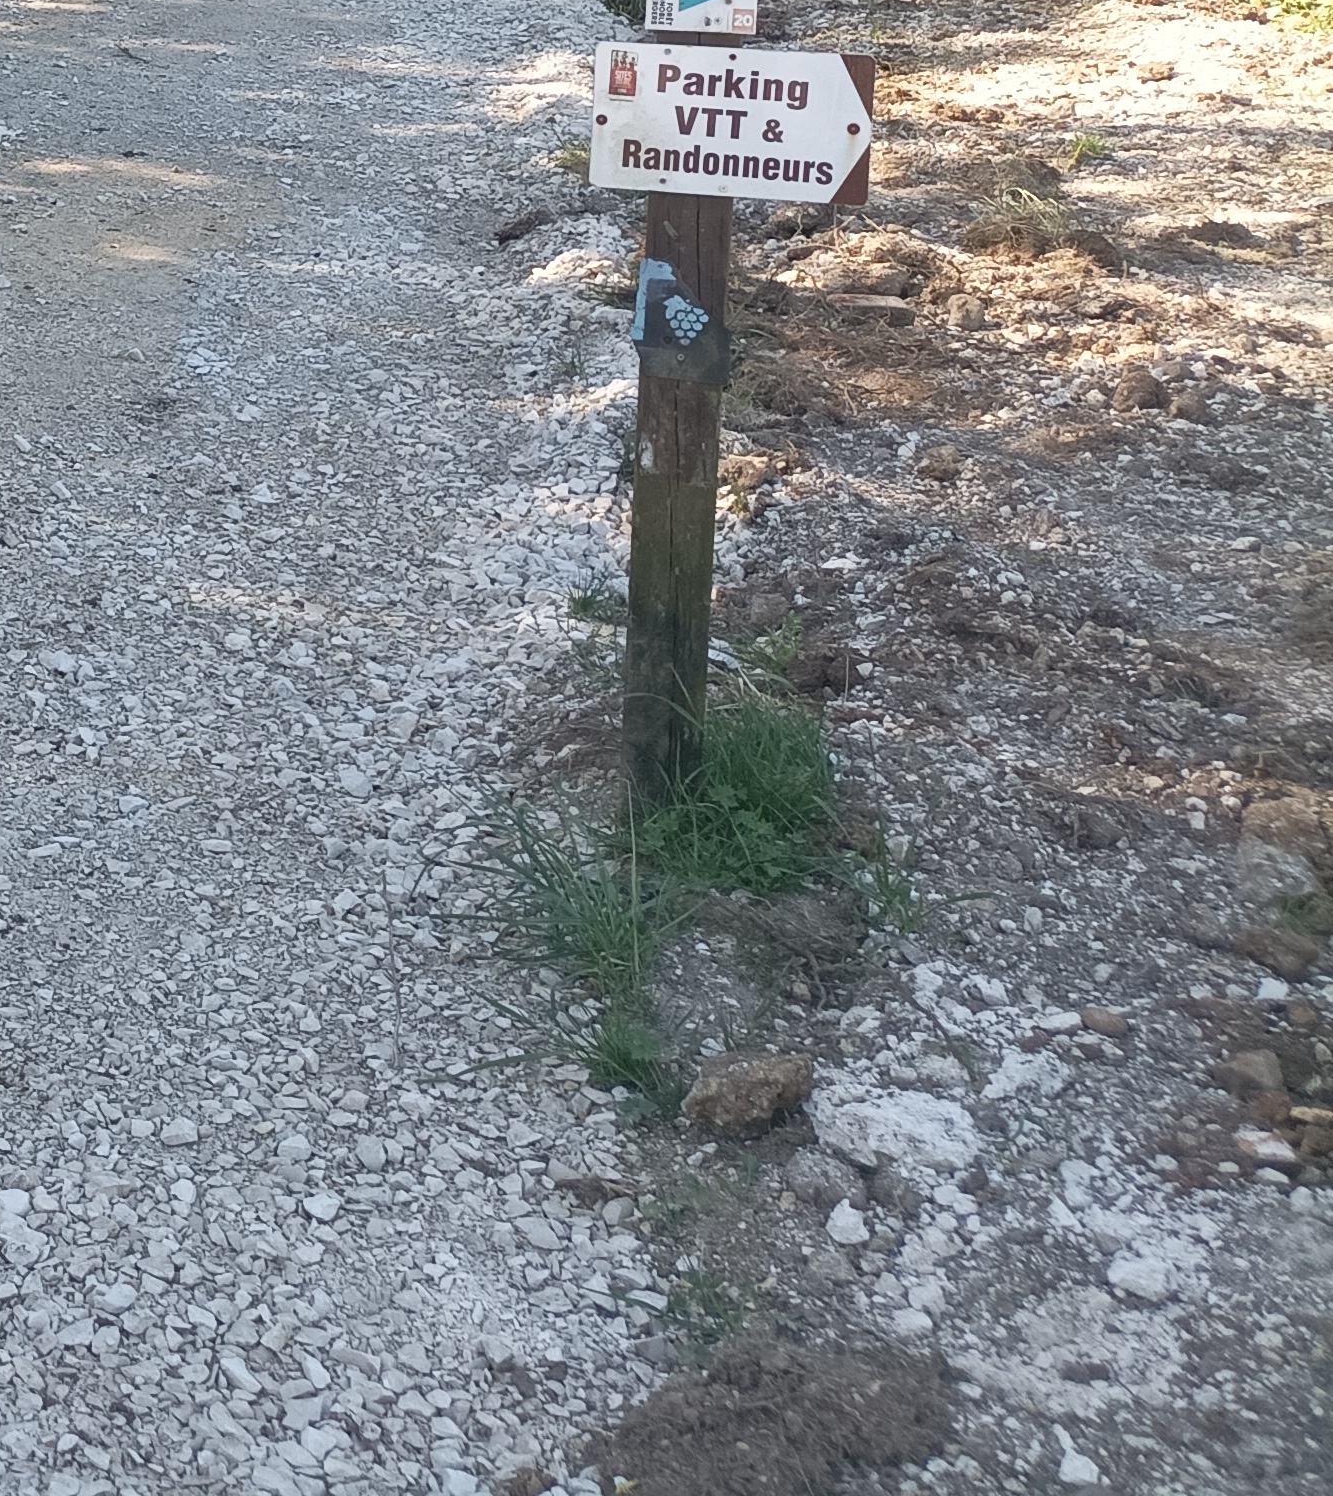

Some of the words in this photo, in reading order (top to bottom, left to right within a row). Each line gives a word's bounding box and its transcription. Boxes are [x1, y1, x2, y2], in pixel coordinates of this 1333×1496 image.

[734, 15, 753, 26] 20
[657, 64, 809, 110] Parking
[675, 106, 748, 140] VTT
[762, 119, 783, 143] &
[622, 139, 833, 185] Randonneurs
